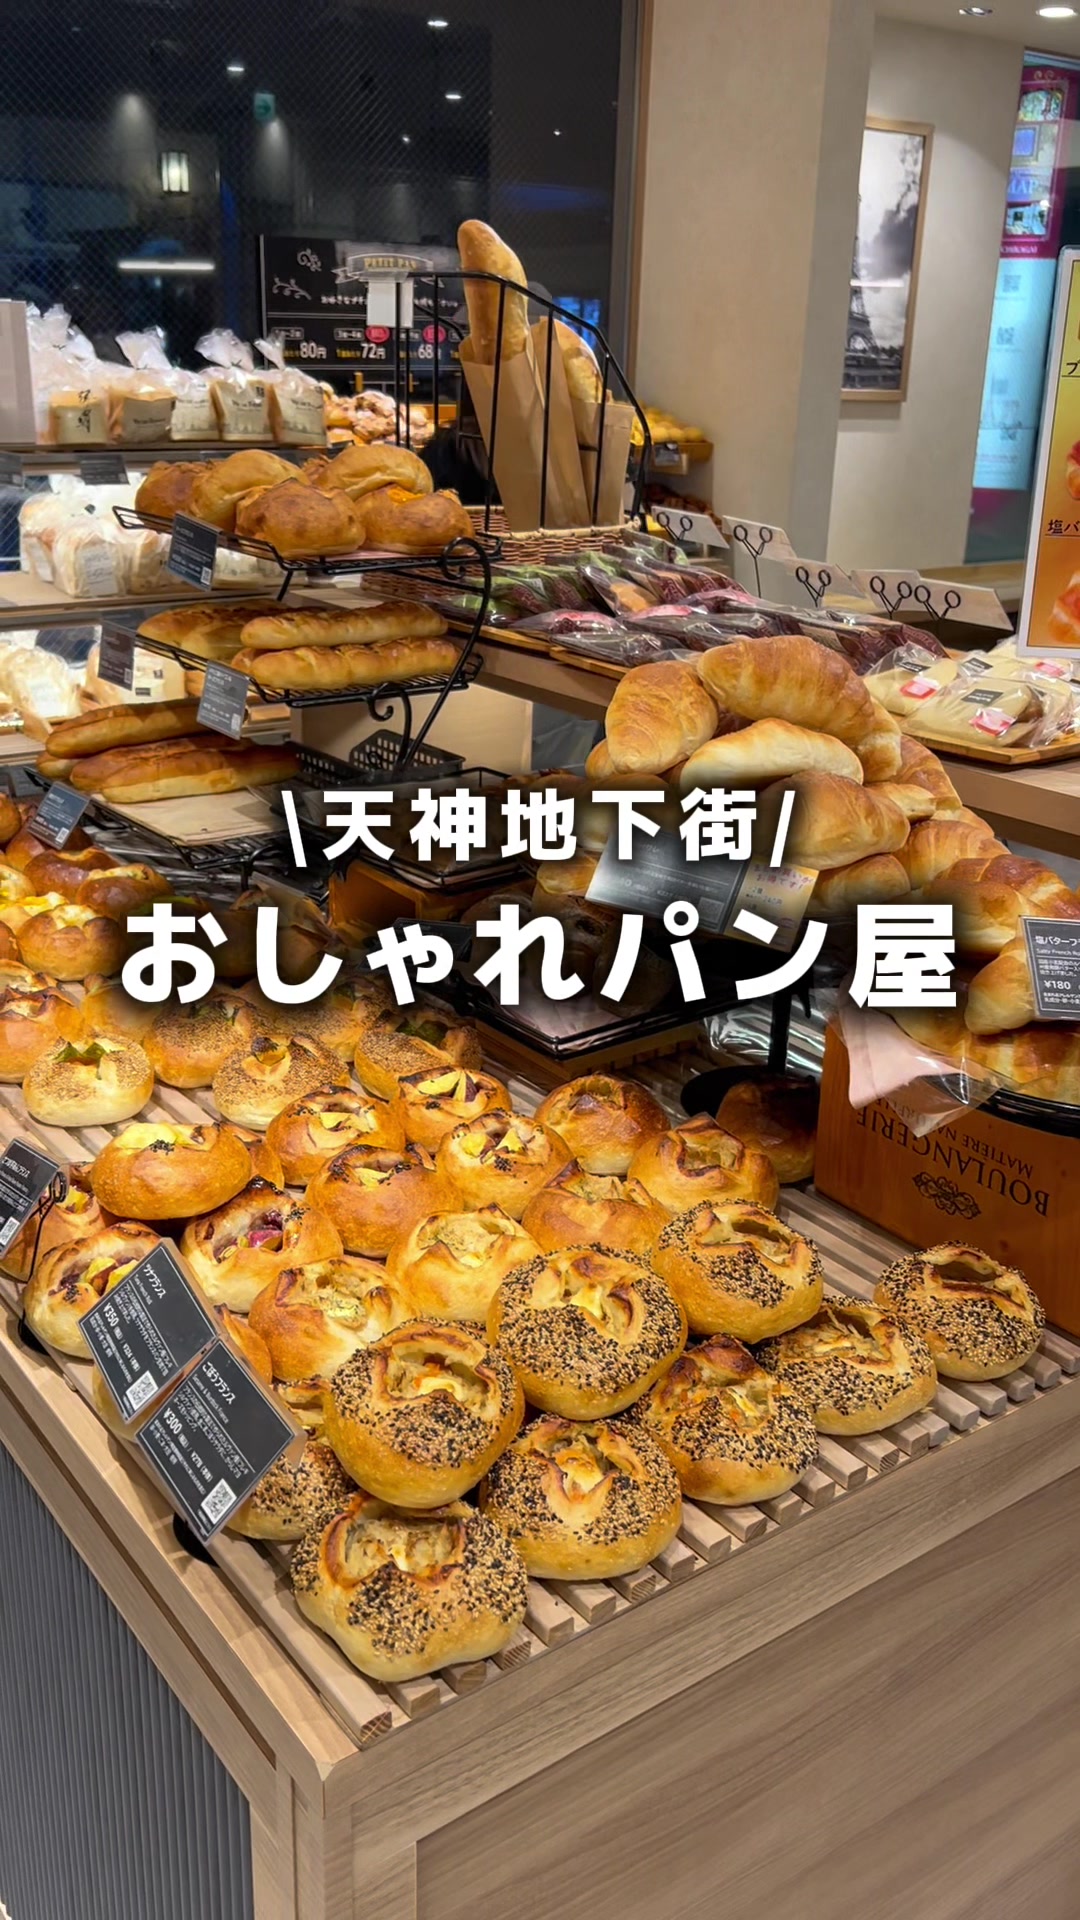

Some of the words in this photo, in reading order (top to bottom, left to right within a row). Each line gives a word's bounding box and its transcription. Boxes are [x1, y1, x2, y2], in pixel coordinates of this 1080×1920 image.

[363, 257, 394, 269] PETIT
[300, 341, 327, 359] 80円
[361, 342, 386, 360] 72円
[1035, 936, 1080, 946] 塩バターフ
[1044, 980, 1071, 990] ¥180
[857, 1106, 1050, 1217] BOULANGERIE
[143, 1262, 166, 1299] ツナフランス
[102, 1302, 118, 1327] ¥350
[201, 1360, 236, 1405] ごぼうフランス
[162, 1407, 182, 1434] ¥300
